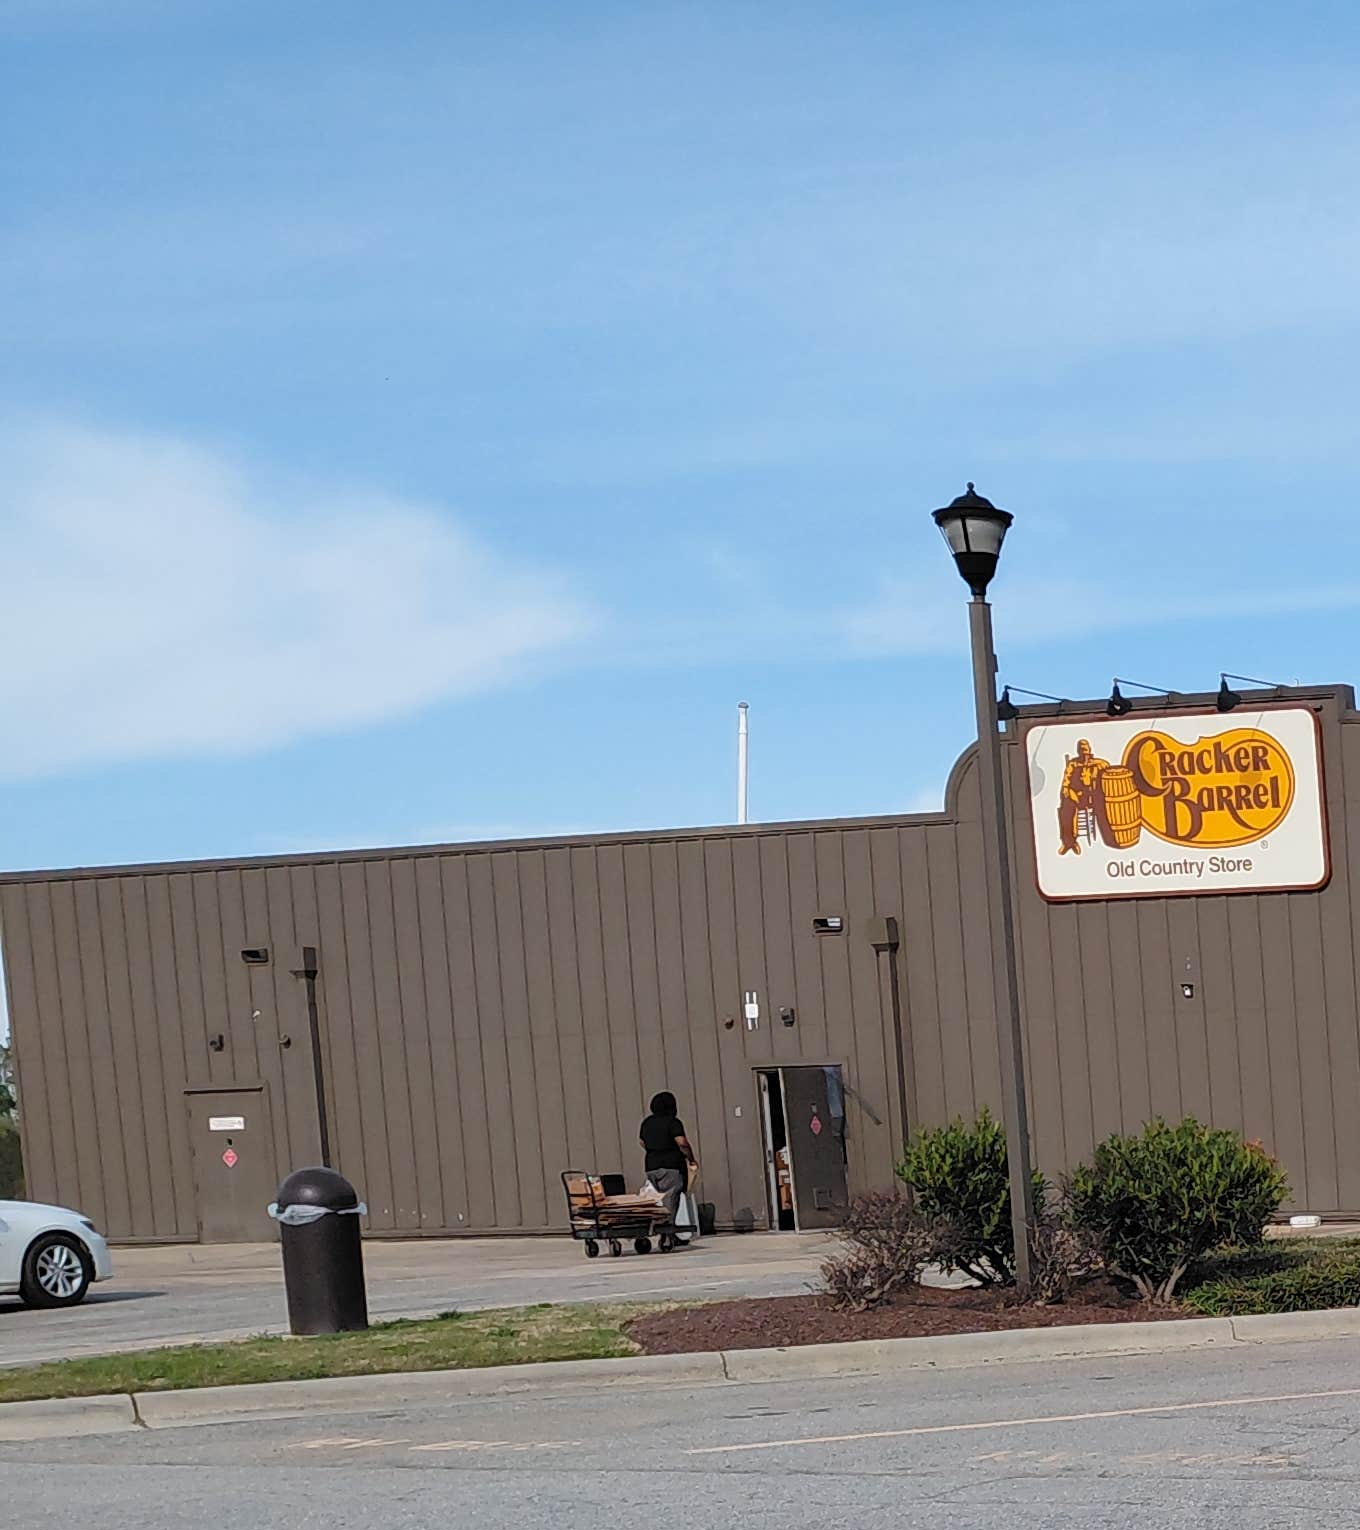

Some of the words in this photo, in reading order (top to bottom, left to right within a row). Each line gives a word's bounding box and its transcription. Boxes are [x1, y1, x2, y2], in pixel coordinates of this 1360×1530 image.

[1127, 736, 1271, 797] Cracker
[1162, 776, 1281, 840] Barrel
[1107, 860, 1135, 878] Old
[1139, 858, 1204, 878] Country
[1209, 856, 1253, 873] Store
